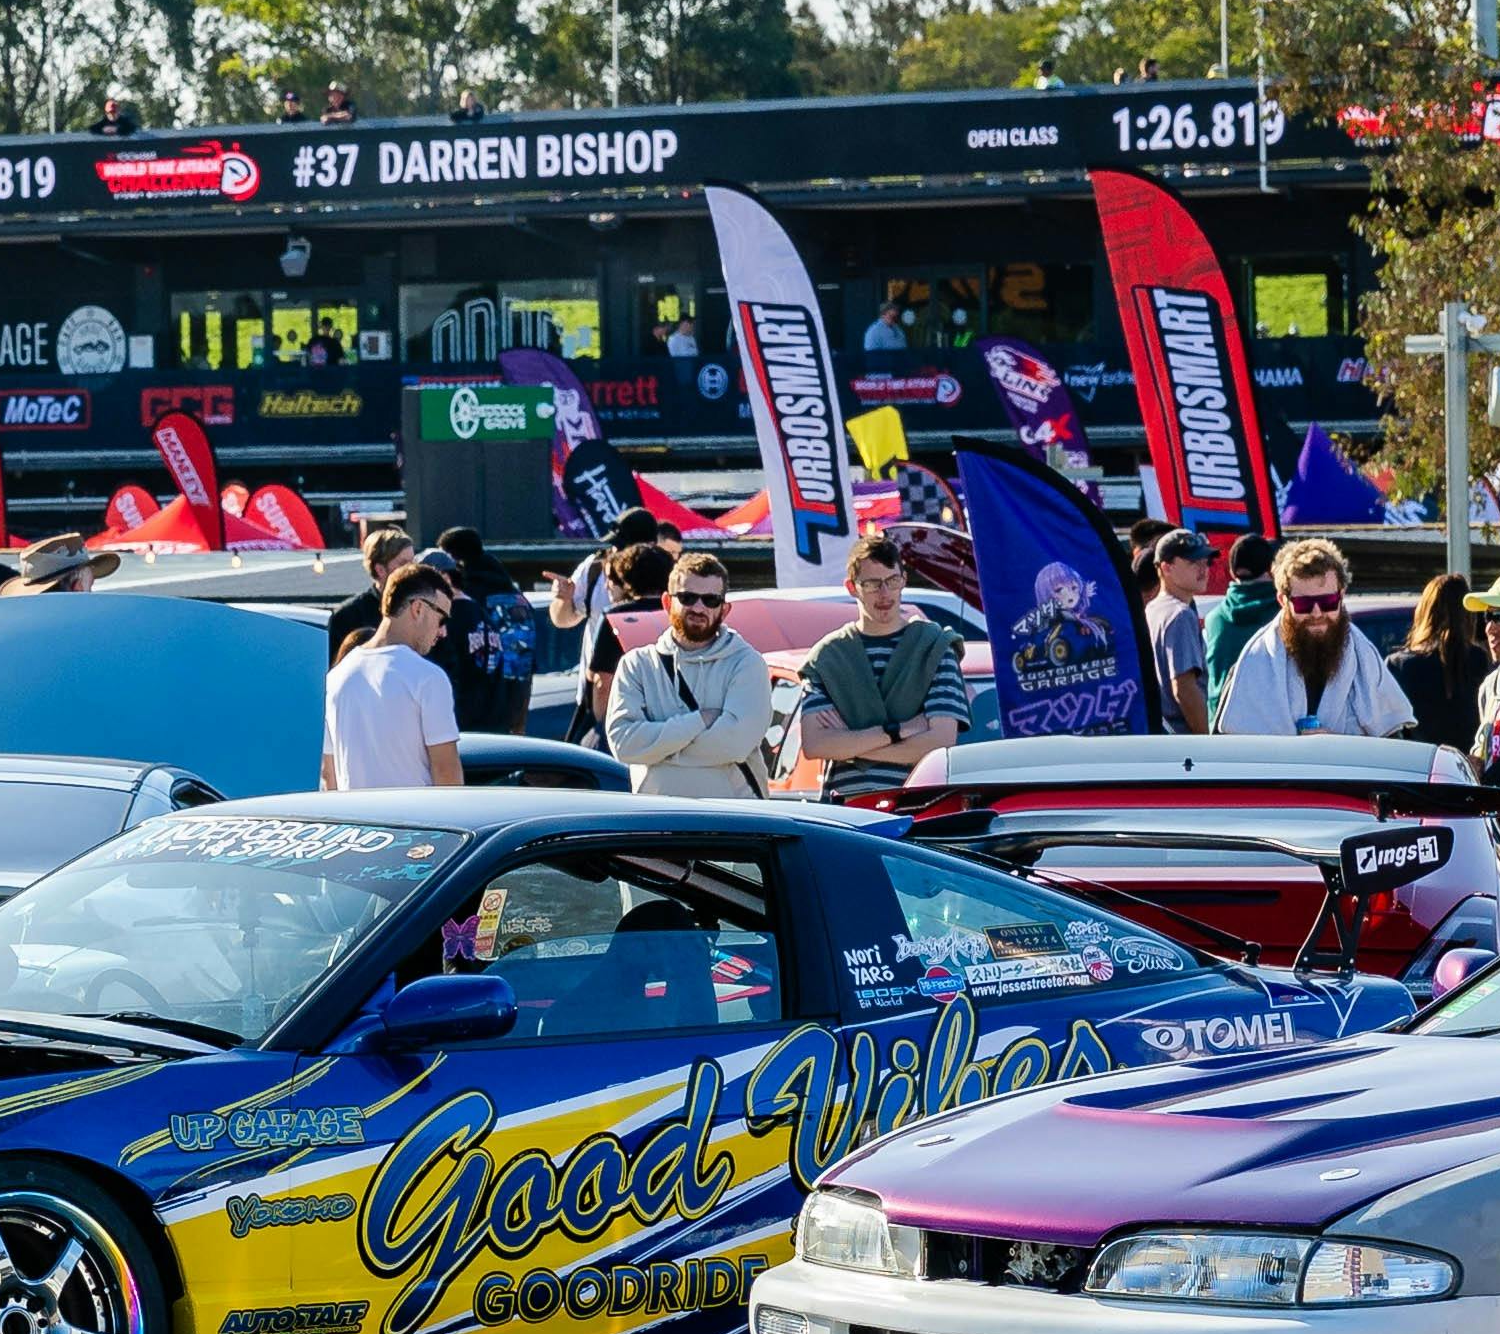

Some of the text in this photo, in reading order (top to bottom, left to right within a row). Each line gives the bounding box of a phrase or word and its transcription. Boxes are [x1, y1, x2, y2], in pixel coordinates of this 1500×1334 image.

[967, 125, 1060, 149] OPEN CLASS
[1113, 100, 1286, 152] 1:26.819
[293, 128, 678, 188] #37 DARREN BISHOP
[2, 395, 81, 425] MoTeC
[259, 391, 362, 417] Haltech
[740, 302, 849, 558] TURBOSMART
[1020, 666, 1118, 692] GARAGE
[145, 817, 396, 854] UNDERGROUND
[228, 838, 350, 861] SPIRIT
[844, 945, 882, 968] Nori
[971, 973, 1091, 999] www.jessestreeter.com
[1184, 1011, 1297, 1051] TOMEI
[744, 992, 1116, 1193] Vibes
[170, 1106, 366, 1151] UP GARAGE
[473, 1253, 769, 1327] GOODRIDE
